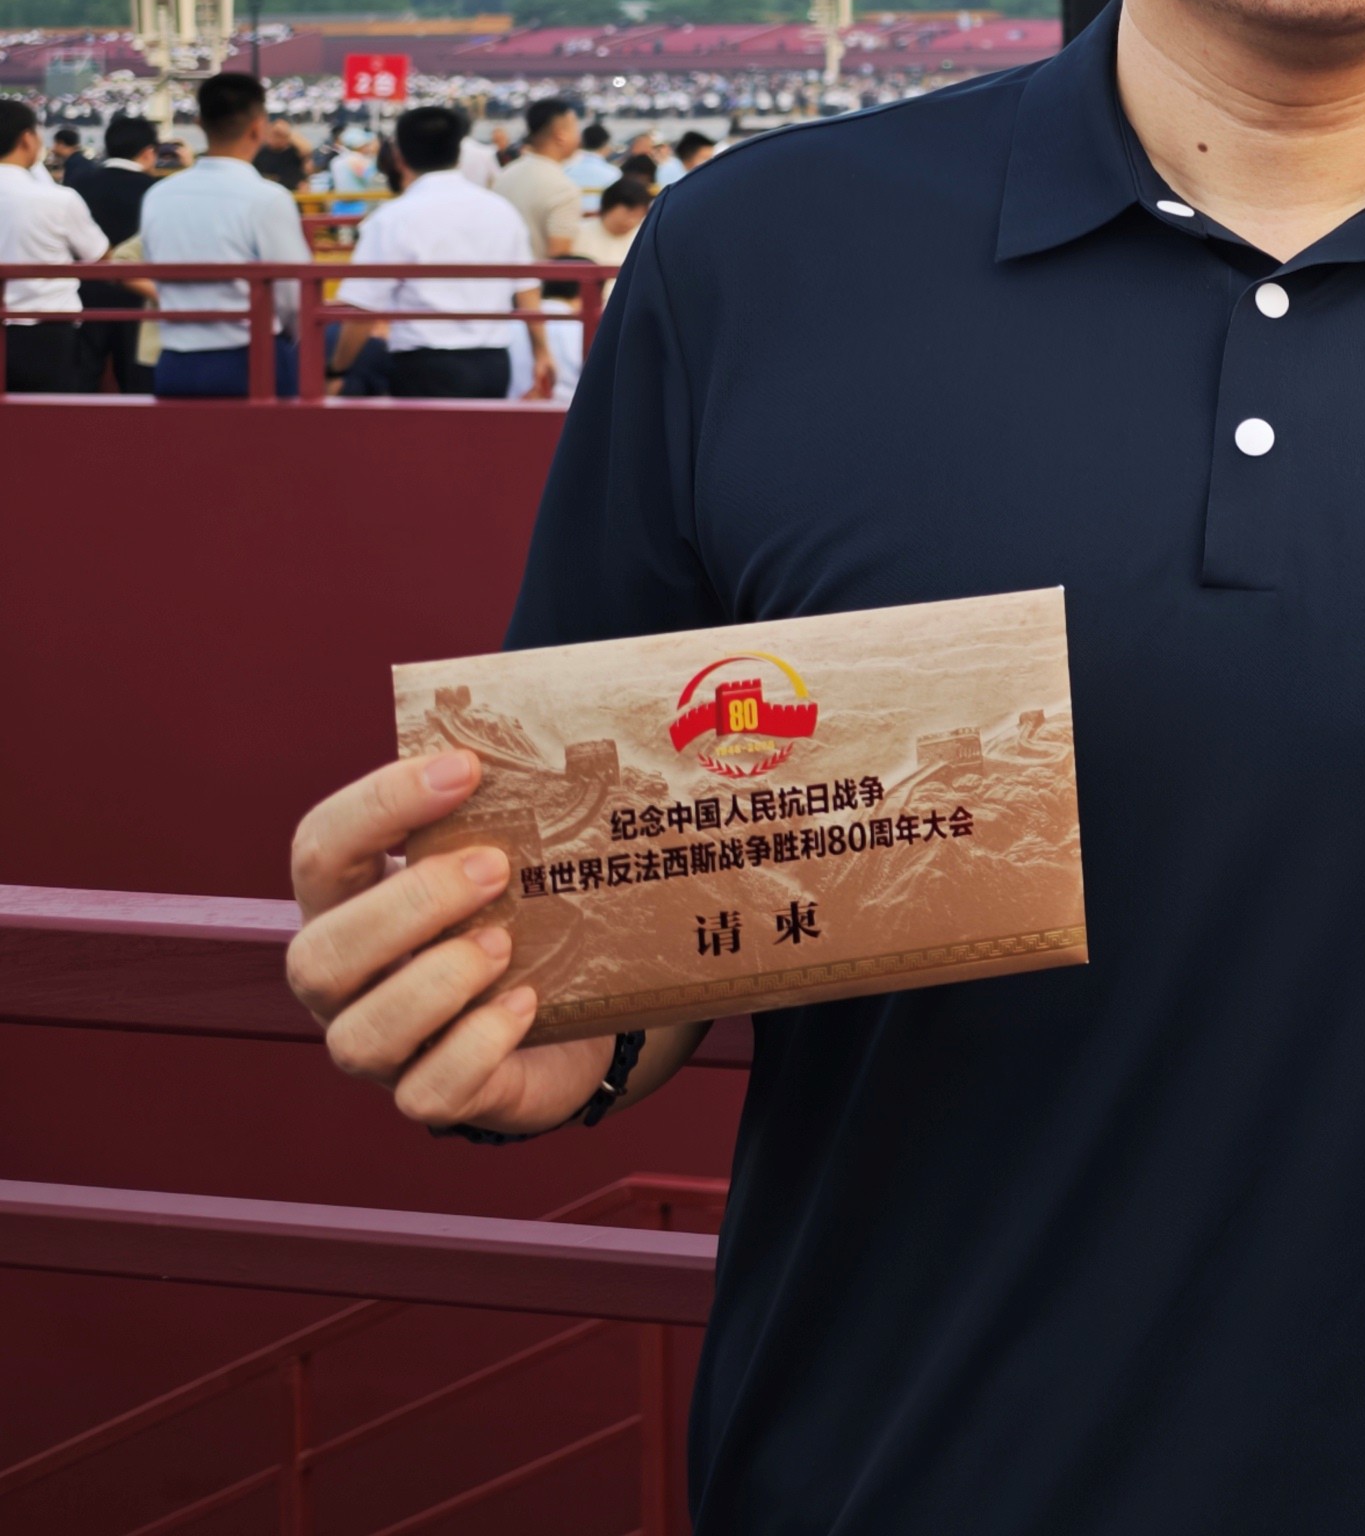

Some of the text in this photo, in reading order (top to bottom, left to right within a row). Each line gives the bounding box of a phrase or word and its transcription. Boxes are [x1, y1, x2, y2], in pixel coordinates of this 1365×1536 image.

[728, 697, 759, 733] 80
[610, 775, 885, 841] 纪念中国人民抗日战争
[520, 805, 975, 899] 暨世界反法西斯战争胜利80周年大会
